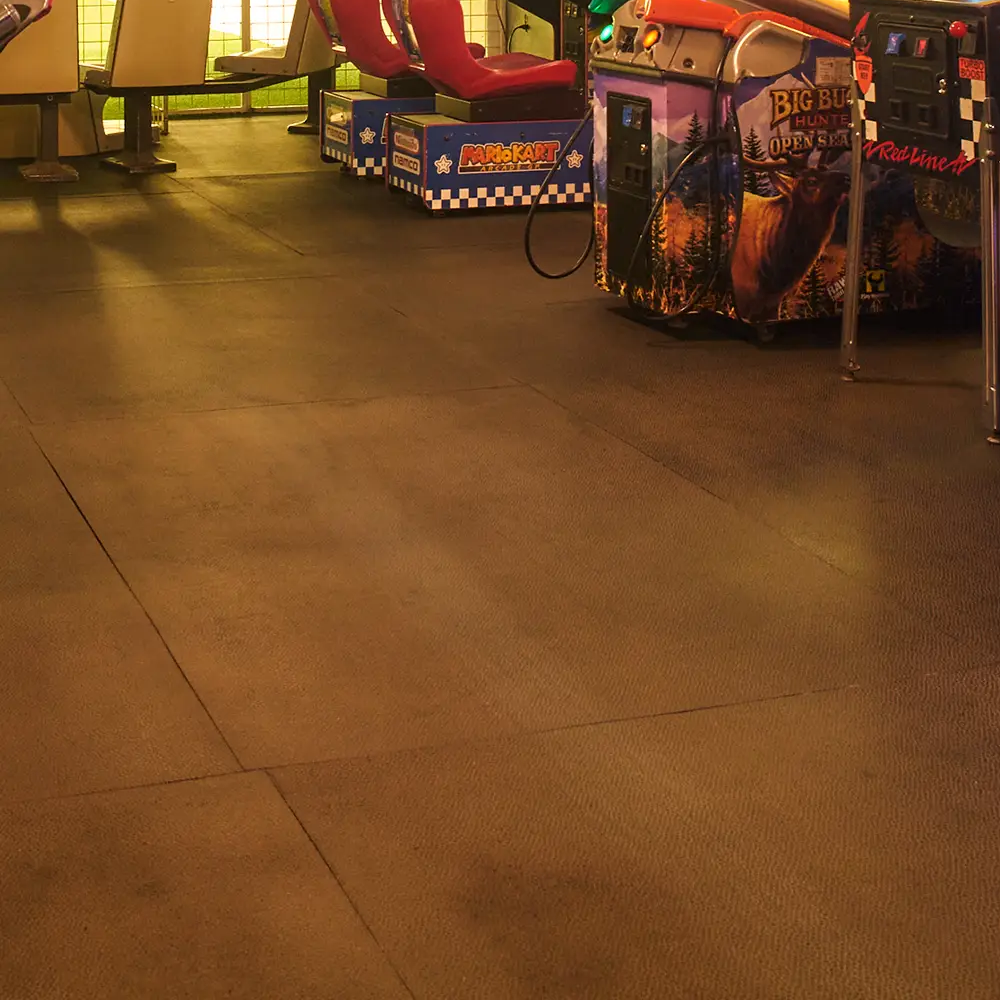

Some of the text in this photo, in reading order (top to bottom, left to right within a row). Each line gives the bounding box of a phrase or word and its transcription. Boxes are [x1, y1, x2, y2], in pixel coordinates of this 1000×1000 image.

[960, 68, 984, 79] BOOST
[770, 88, 851, 130] BIG BU
[795, 114, 849, 127] HUNTE
[461, 142, 559, 165] MARIO KART
[769, 133, 850, 159] OPEN SEA
[395, 156, 418, 171] namco
[480, 163, 521, 172] ARCADE
